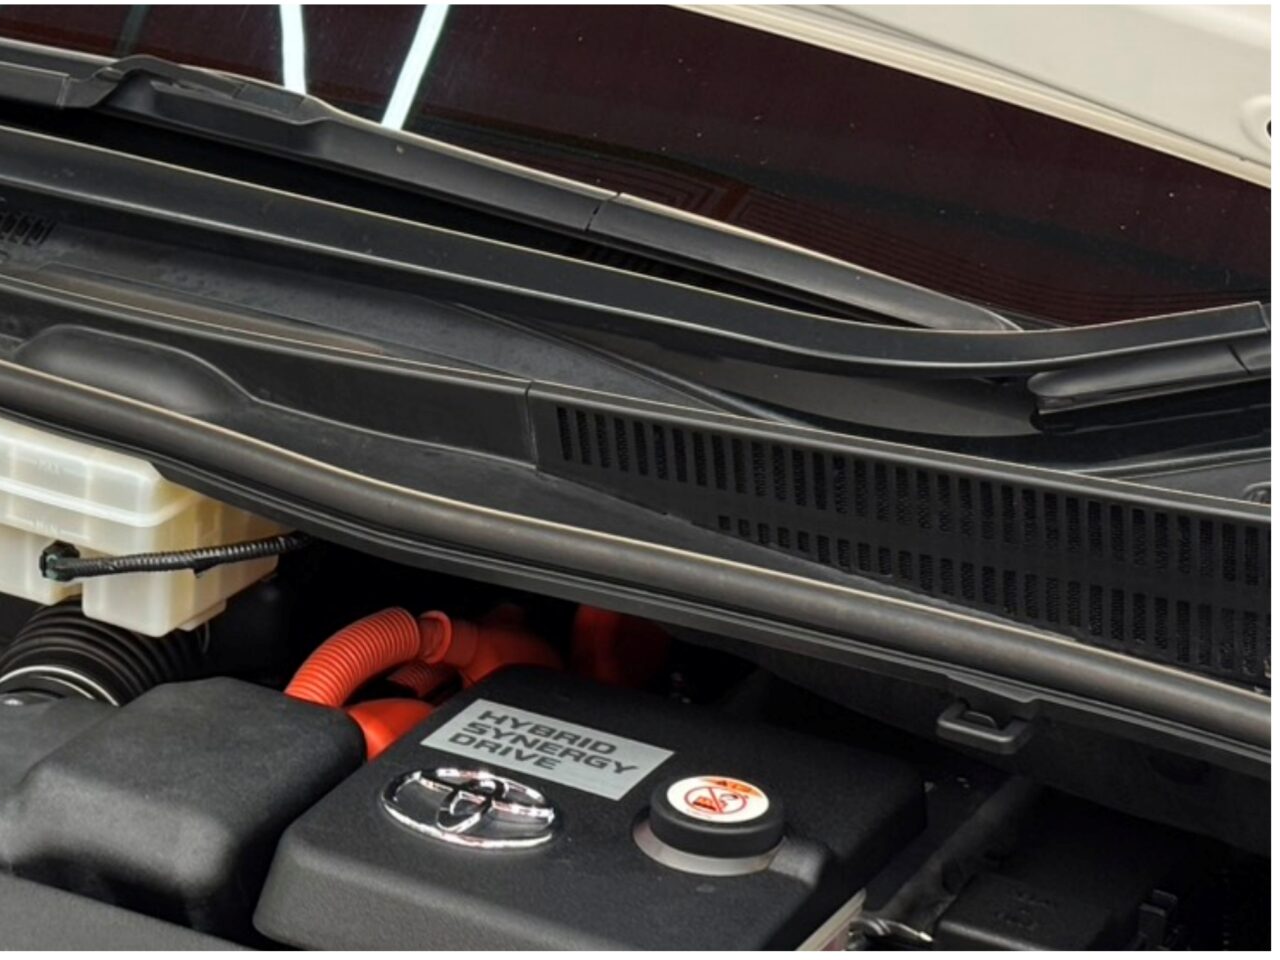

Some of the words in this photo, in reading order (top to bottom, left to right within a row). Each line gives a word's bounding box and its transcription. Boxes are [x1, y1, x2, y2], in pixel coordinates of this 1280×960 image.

[449, 732, 562, 771] DRIVE
[462, 721, 641, 775] SYNERGY
[477, 710, 618, 755] HYBRID
